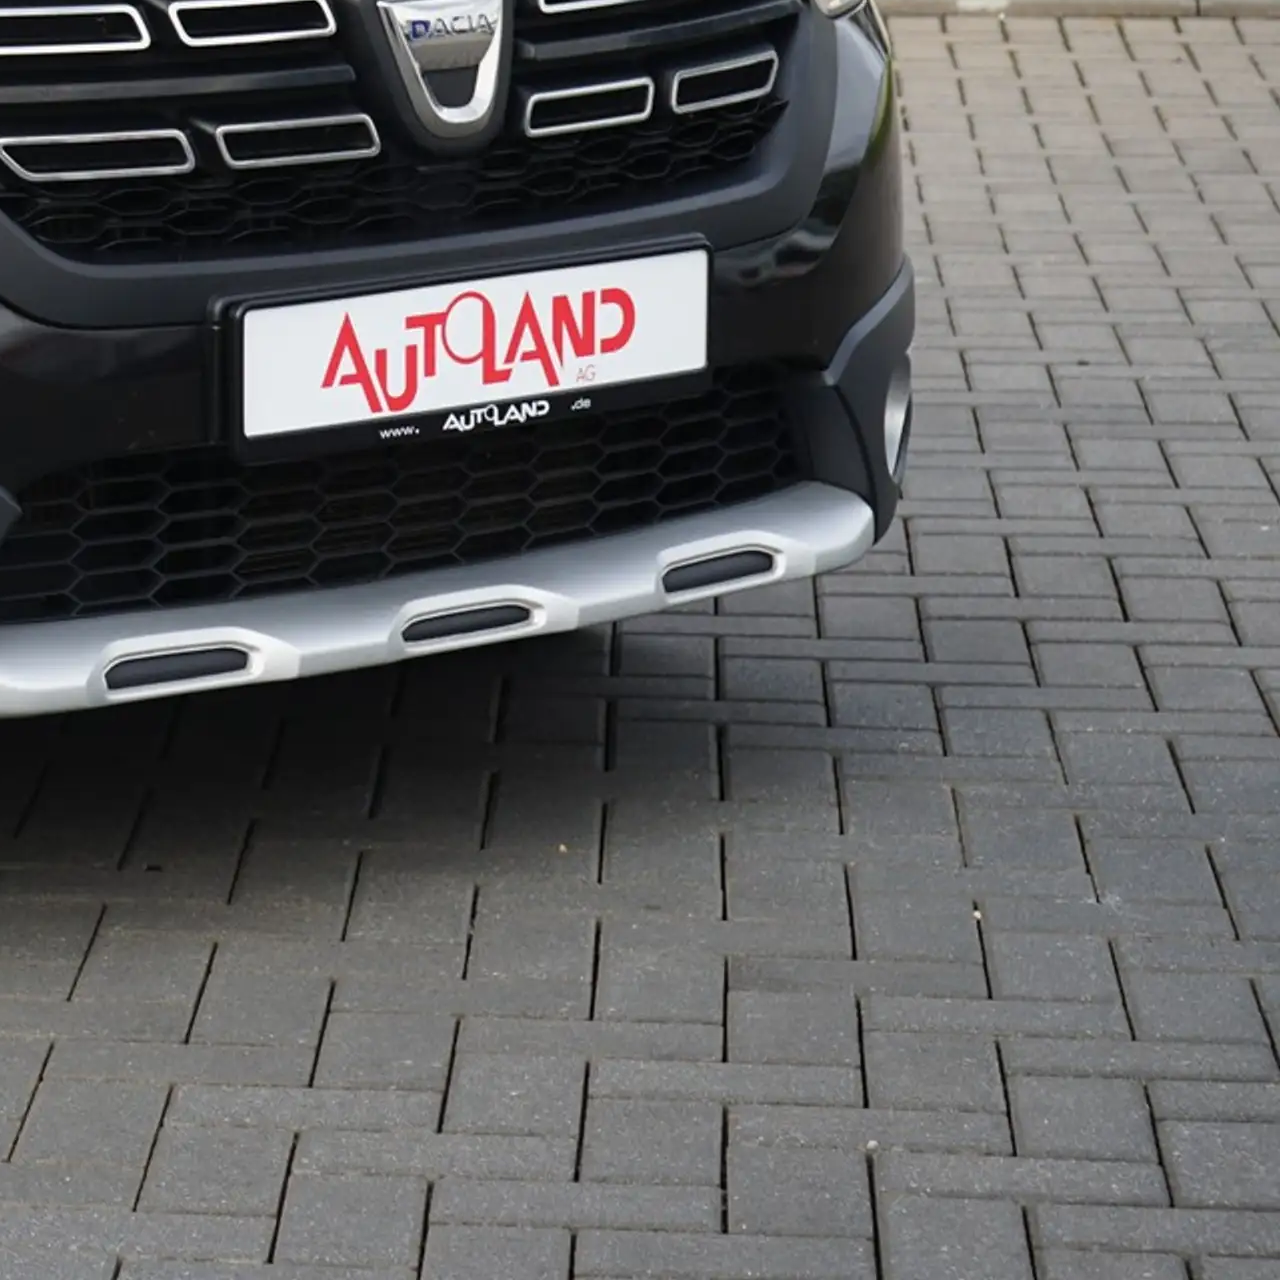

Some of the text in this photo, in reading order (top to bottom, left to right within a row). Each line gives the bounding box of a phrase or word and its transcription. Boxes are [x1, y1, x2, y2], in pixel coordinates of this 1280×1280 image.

[409, 14, 496, 40] DACIA
[321, 287, 636, 414] AUTOLAND
[575, 364, 596, 383] AG
[442, 399, 550, 433] AUTOLAND
